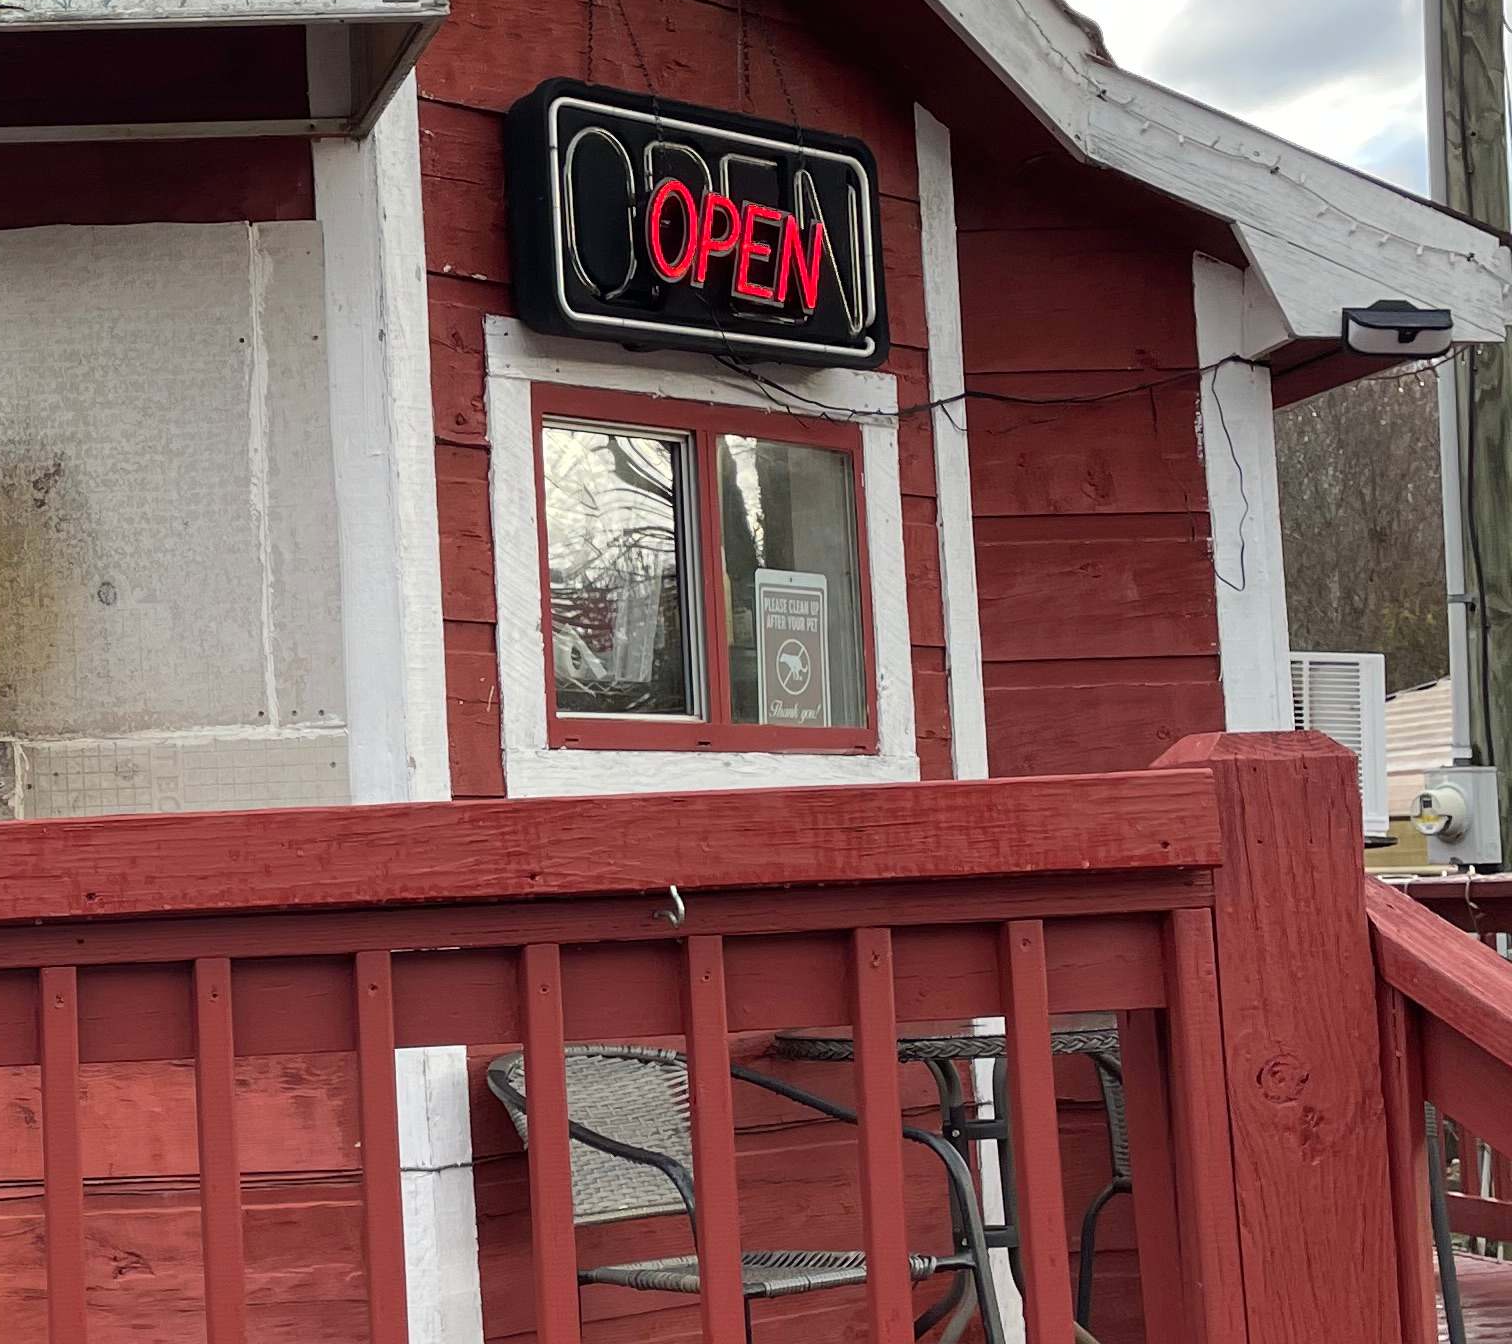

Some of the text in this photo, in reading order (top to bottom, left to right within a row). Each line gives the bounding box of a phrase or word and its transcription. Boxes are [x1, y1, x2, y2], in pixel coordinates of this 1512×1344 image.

[648, 178, 824, 311] OPEN
[764, 597, 819, 616] PLEASE CLEAN UP
[766, 613, 818, 633] AFTER YOUR PET
[769, 699, 822, 724] Thank you!
